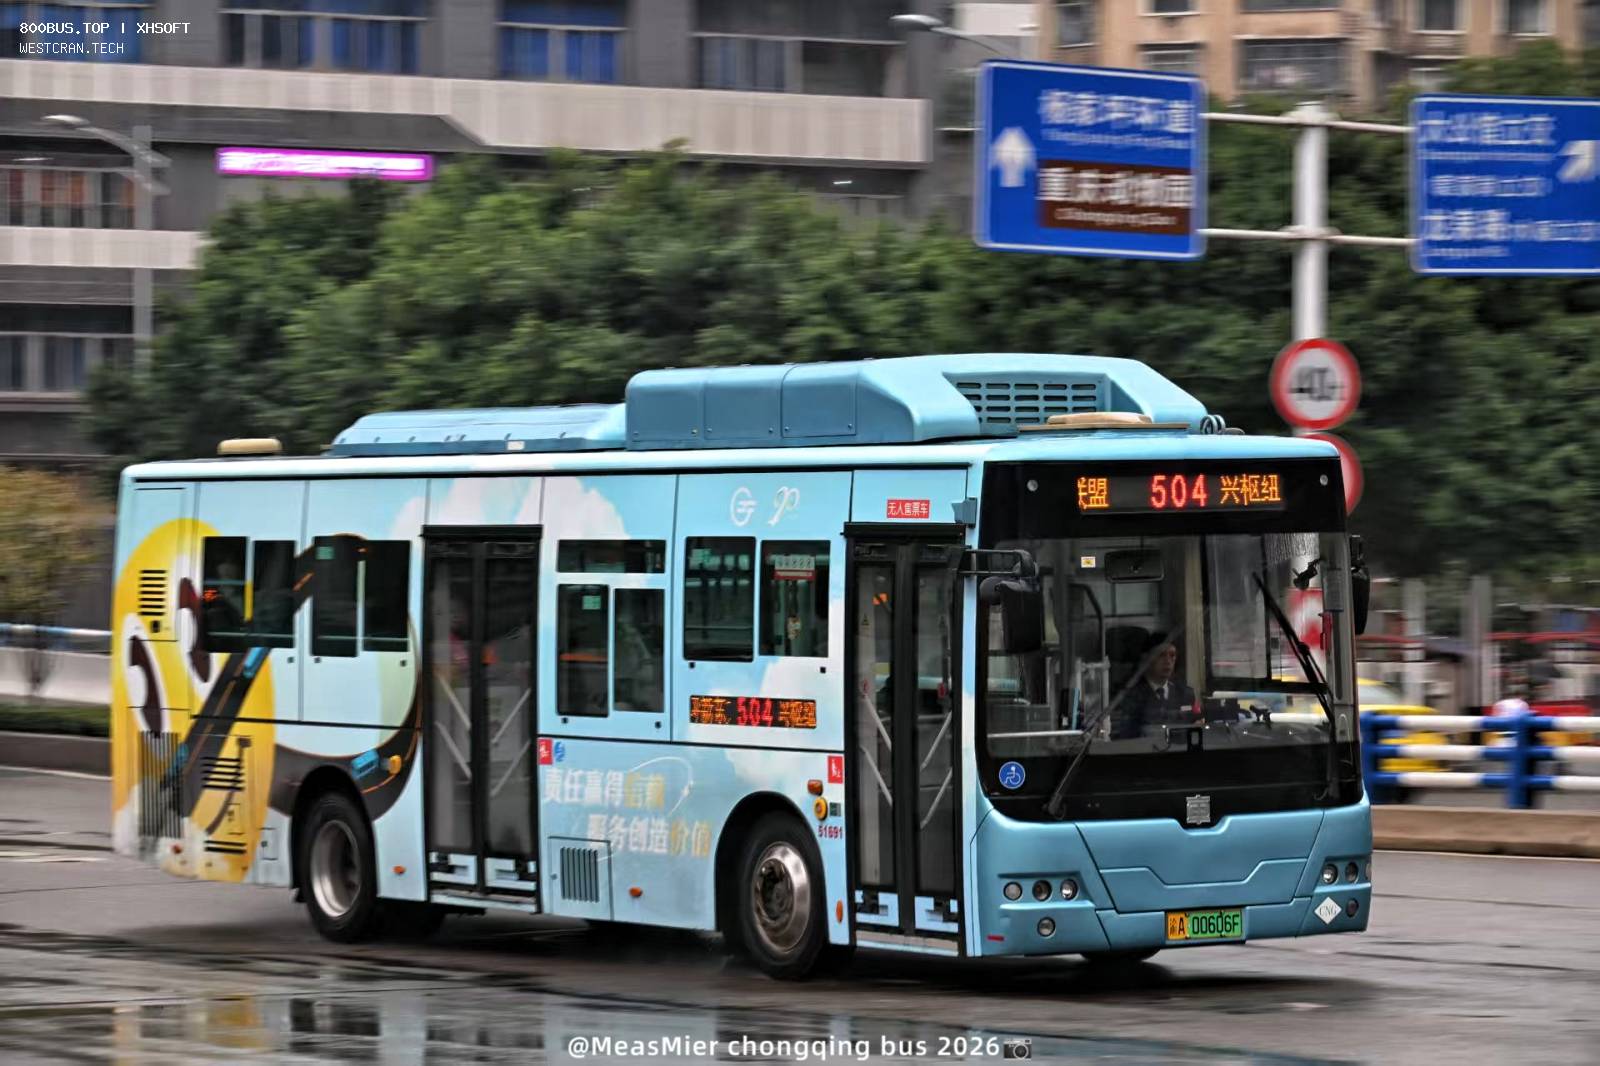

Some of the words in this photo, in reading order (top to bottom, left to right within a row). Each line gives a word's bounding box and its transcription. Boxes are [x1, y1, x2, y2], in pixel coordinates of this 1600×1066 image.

[1151, 474, 1207, 508] 504
[1220, 474, 1281, 506] 兴枢纽
[887, 502, 929, 517] 无人售票车
[736, 696, 773, 727] 504
